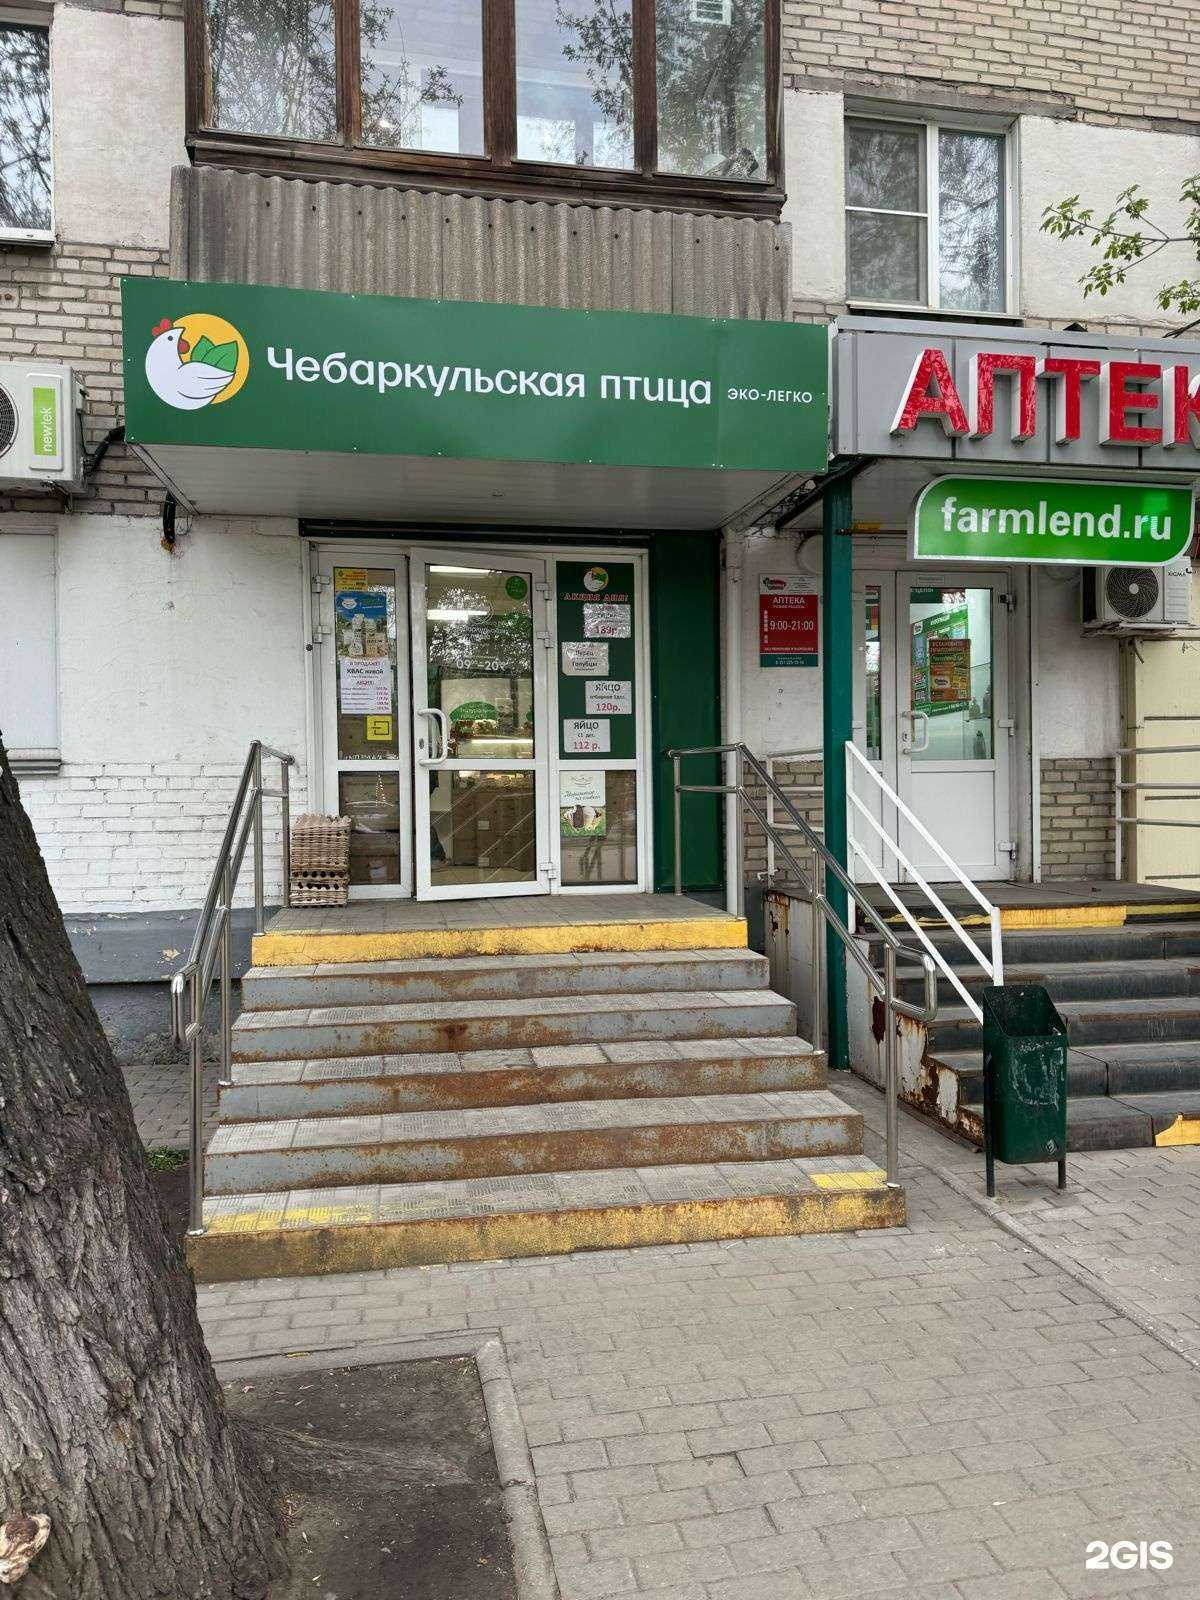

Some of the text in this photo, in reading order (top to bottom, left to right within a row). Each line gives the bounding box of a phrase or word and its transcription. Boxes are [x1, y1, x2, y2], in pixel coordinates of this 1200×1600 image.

[267, 346, 812, 408] Чебаркульская птица ЭКО-ЛЕГКО
[41, 407, 53, 452] newtek
[941, 496, 1171, 541] farmlend.ru
[772, 596, 806, 604] АПТЕКА
[769, 620, 814, 631] 9:00-21:00
[595, 683, 621, 693] ЯЙЦО
[596, 702, 621, 712] 120р.
[574, 721, 599, 731] ЯЙЦО
[573, 741, 590, 750] 112
